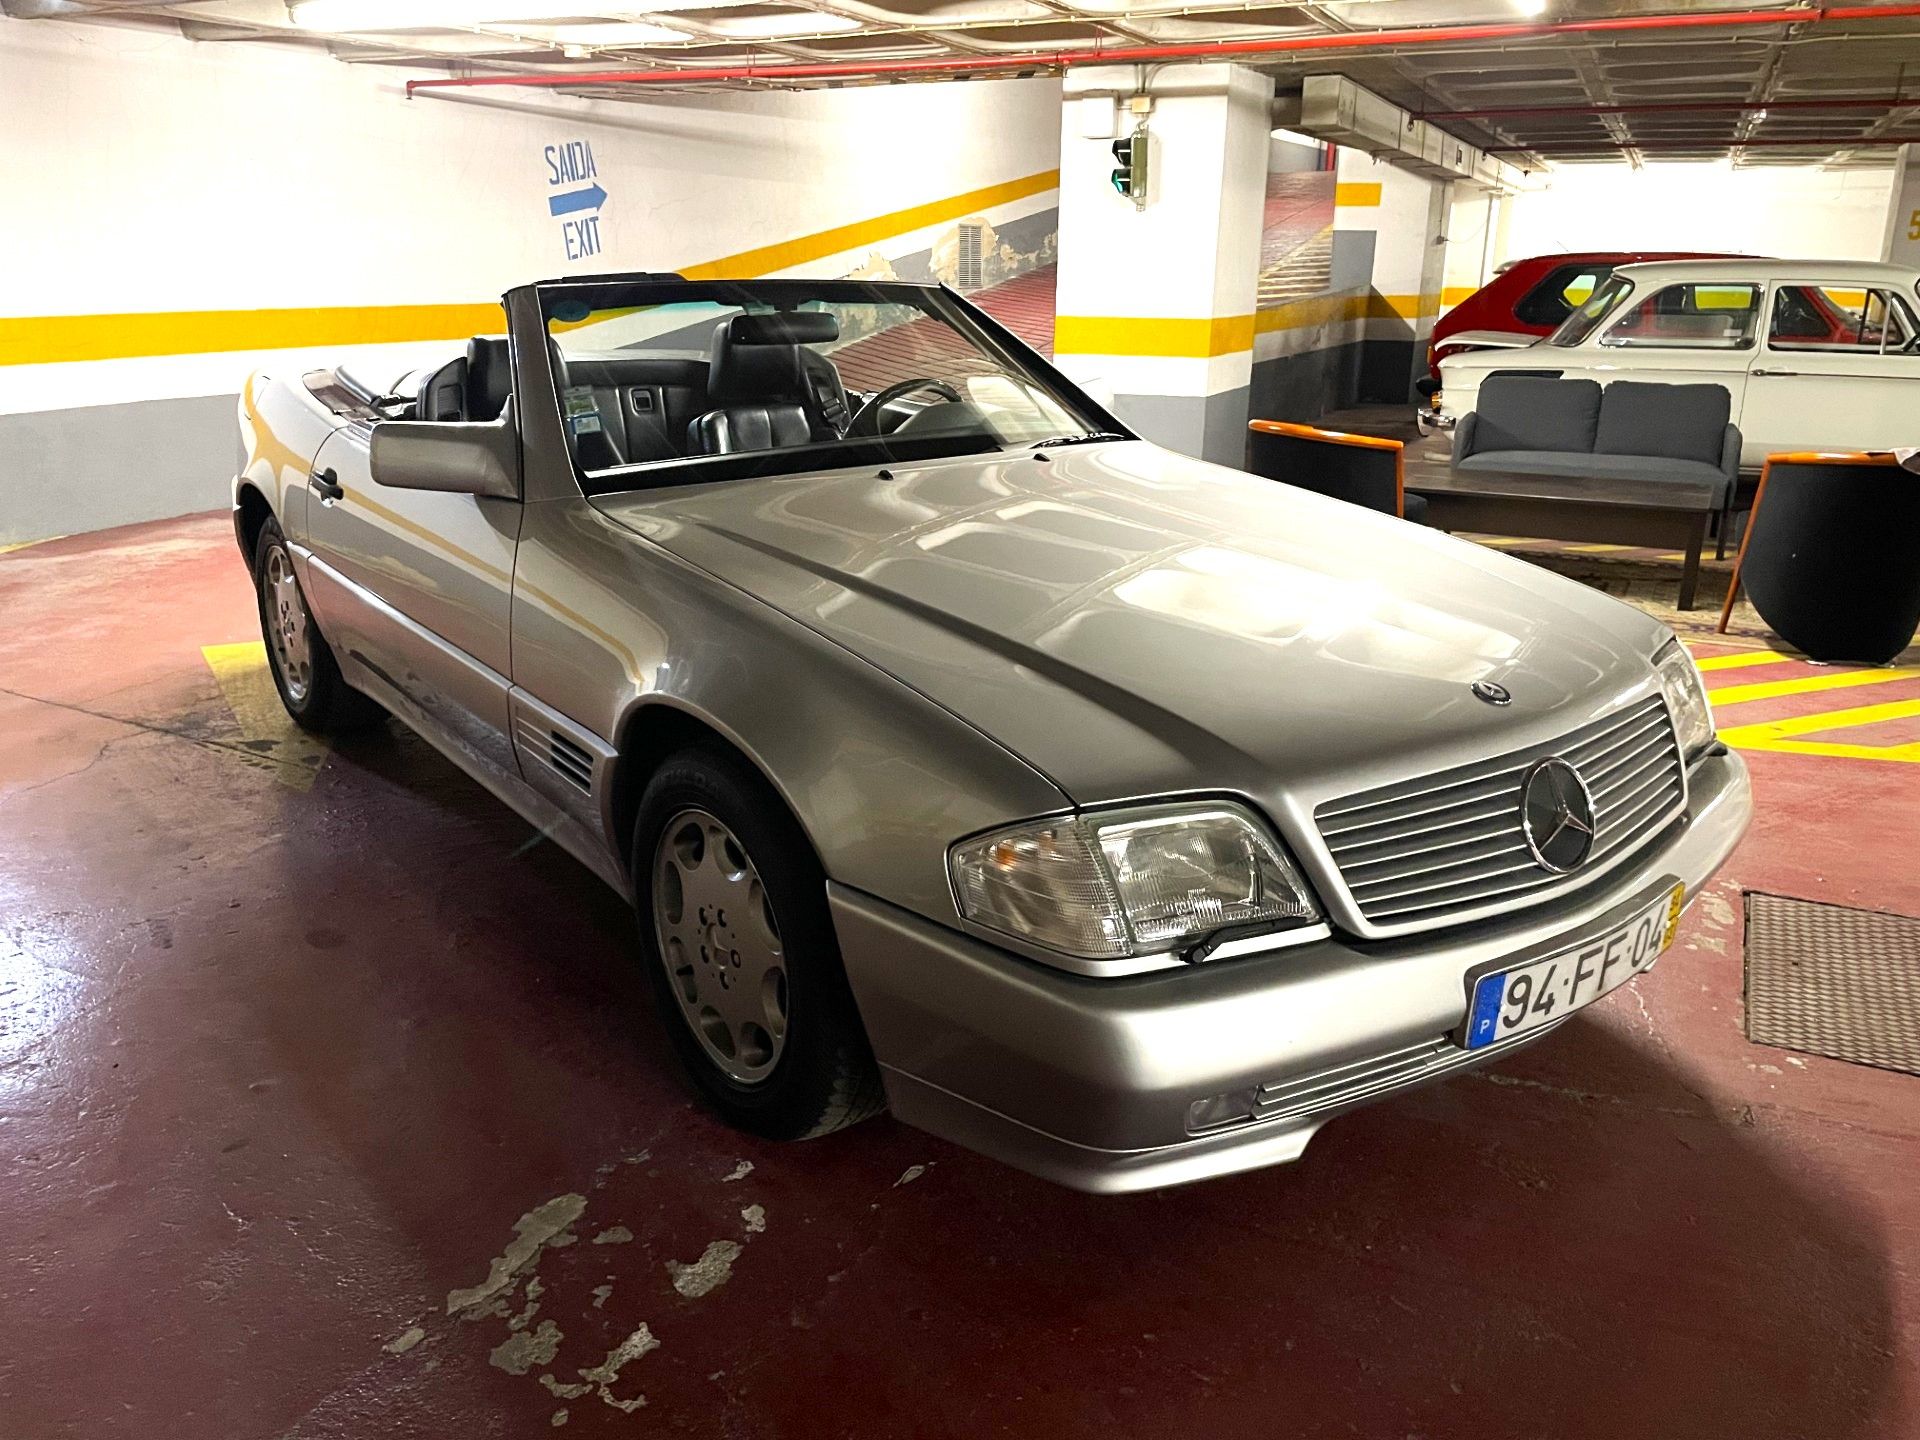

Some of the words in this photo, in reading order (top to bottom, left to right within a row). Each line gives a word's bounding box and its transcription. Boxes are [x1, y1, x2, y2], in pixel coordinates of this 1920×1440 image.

[544, 140, 597, 185] SAIDA
[562, 216, 601, 261] EXIT
[1479, 1019, 1490, 1034] P
